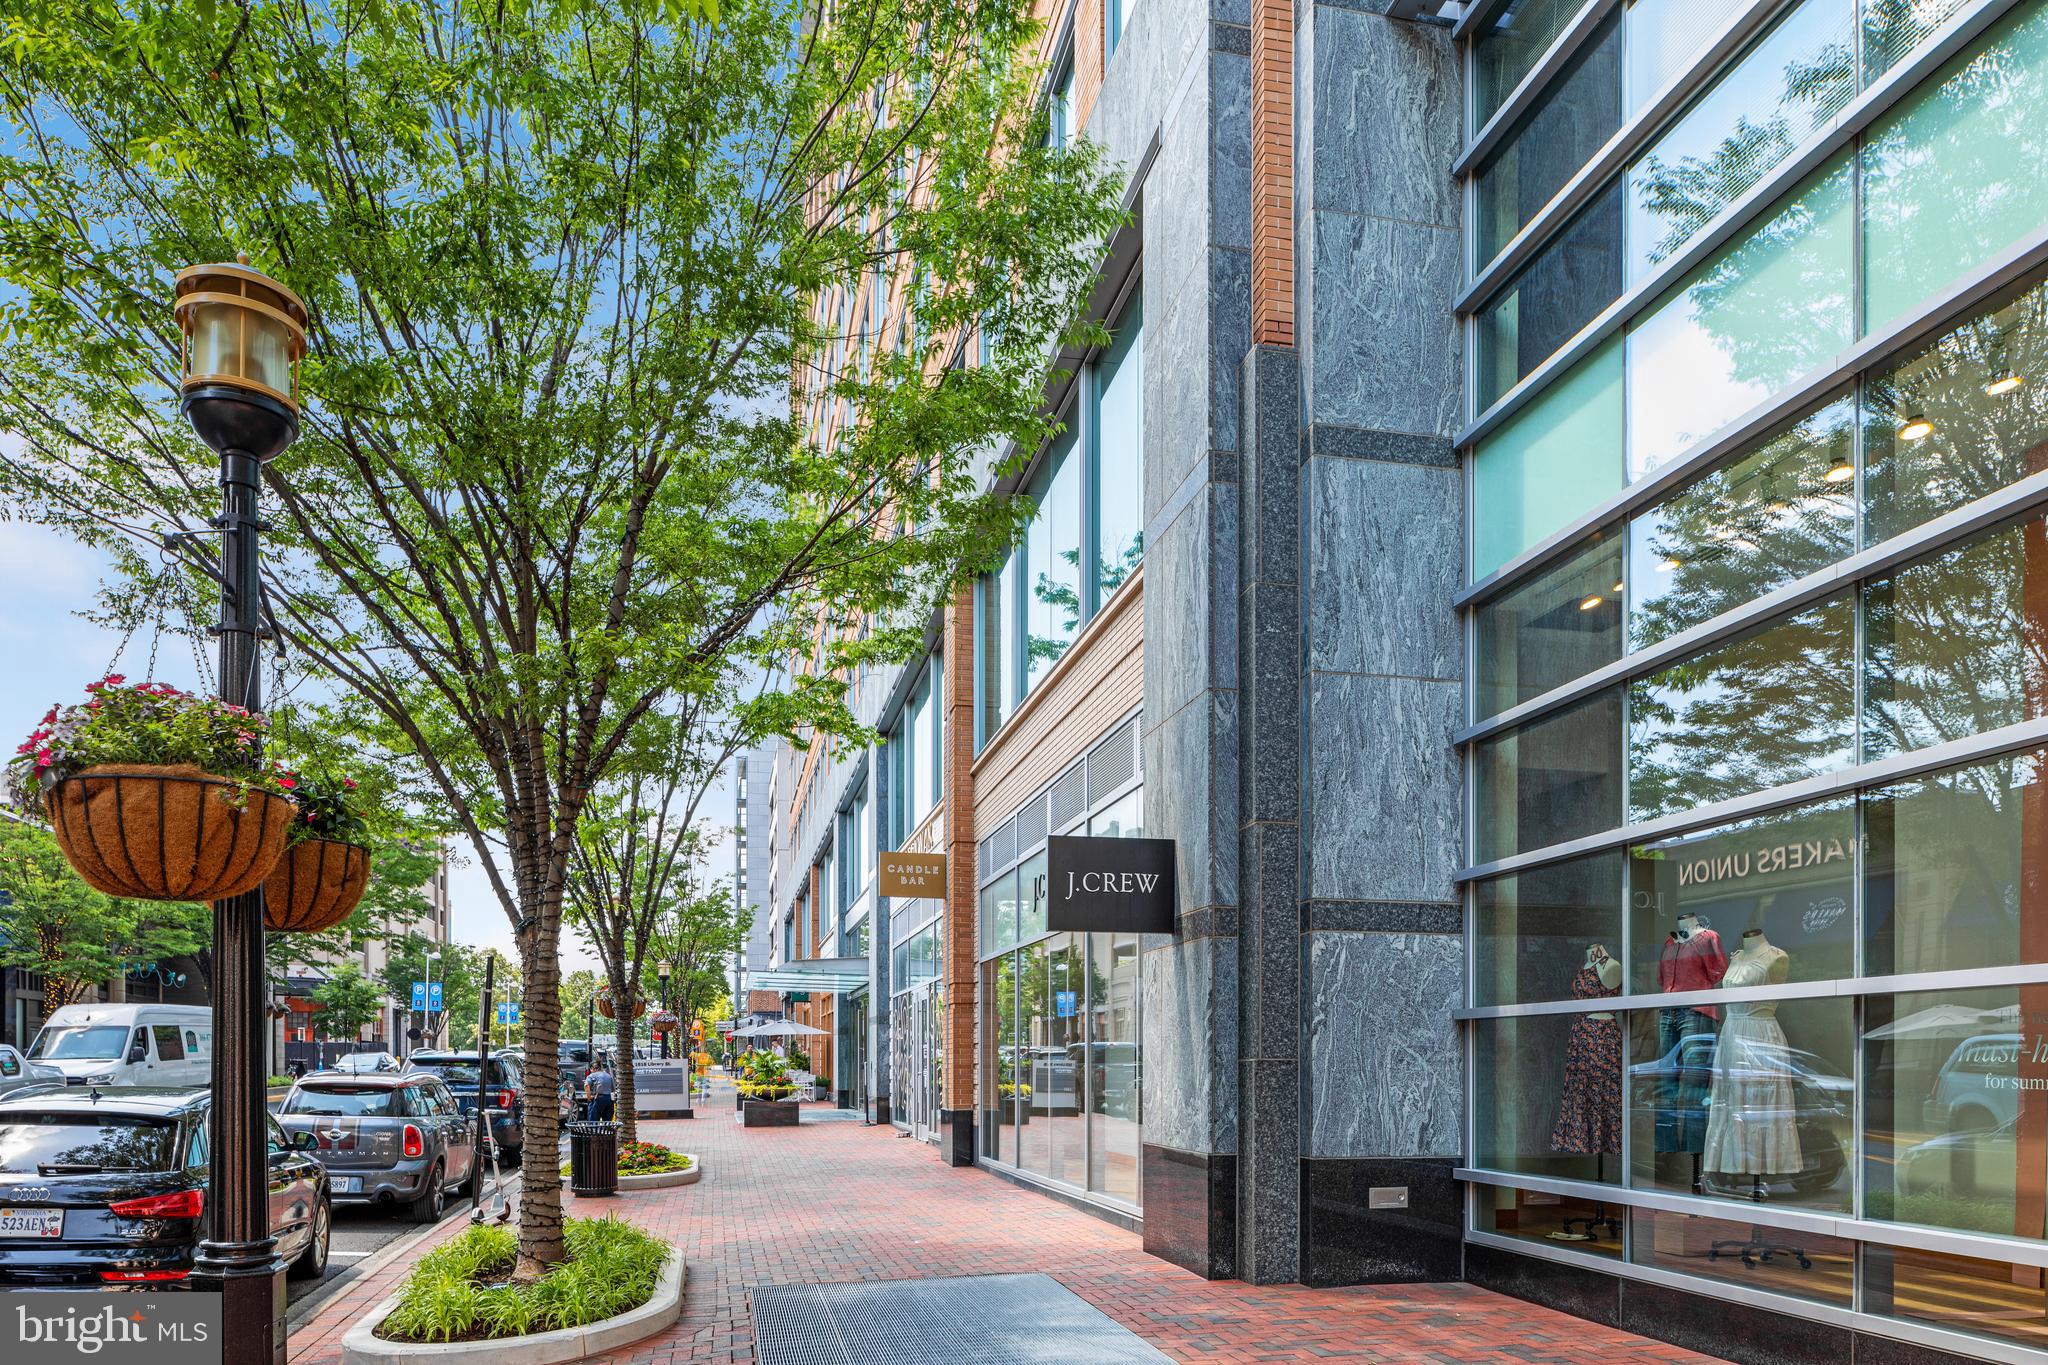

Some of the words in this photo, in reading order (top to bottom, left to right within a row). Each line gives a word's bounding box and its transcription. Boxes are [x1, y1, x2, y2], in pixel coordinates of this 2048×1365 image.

[887, 864, 939, 875] CANDLE
[900, 876, 925, 885] BAR
[1065, 871, 1160, 900] J.CREW
[1984, 1072, 2007, 1089] for
[1, 1217, 46, 1231] 523AEN
